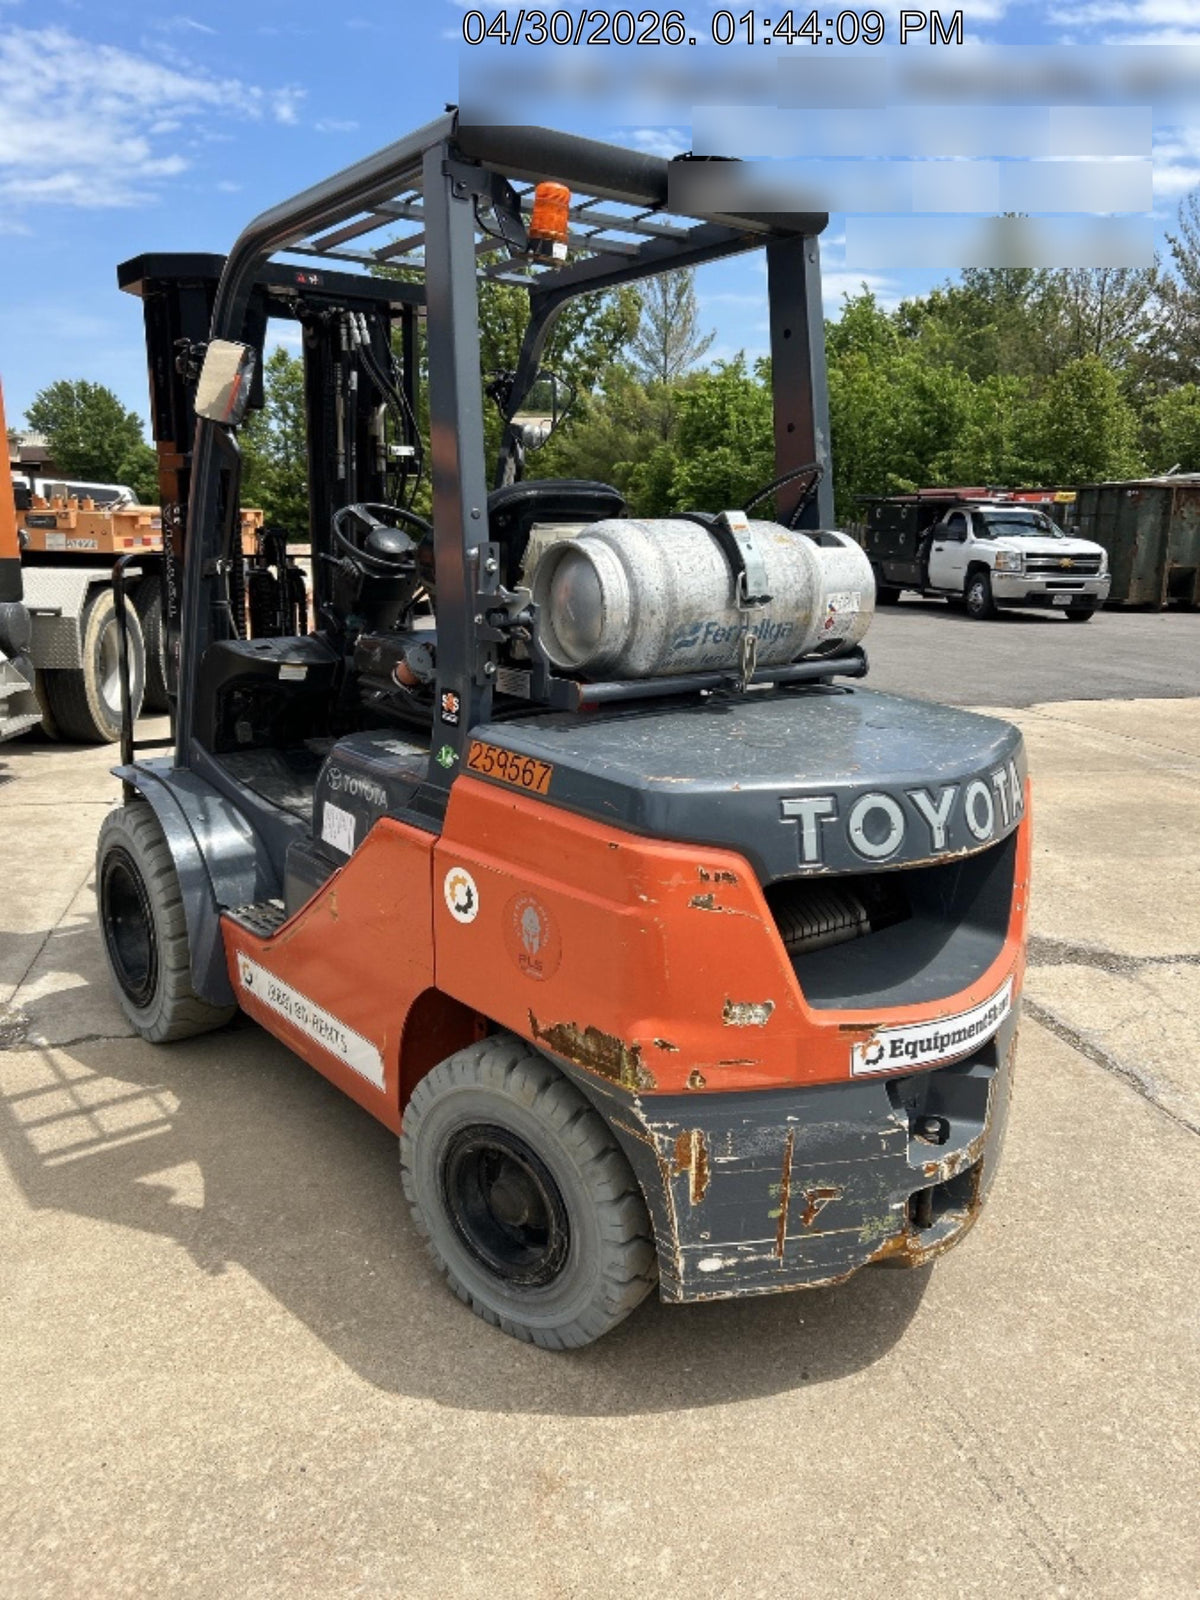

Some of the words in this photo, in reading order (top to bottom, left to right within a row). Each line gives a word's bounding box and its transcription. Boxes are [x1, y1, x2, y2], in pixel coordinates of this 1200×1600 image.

[468, 742, 552, 791] 259567
[342, 774, 388, 809] TOYOTA
[779, 756, 1025, 866] TOYOTA
